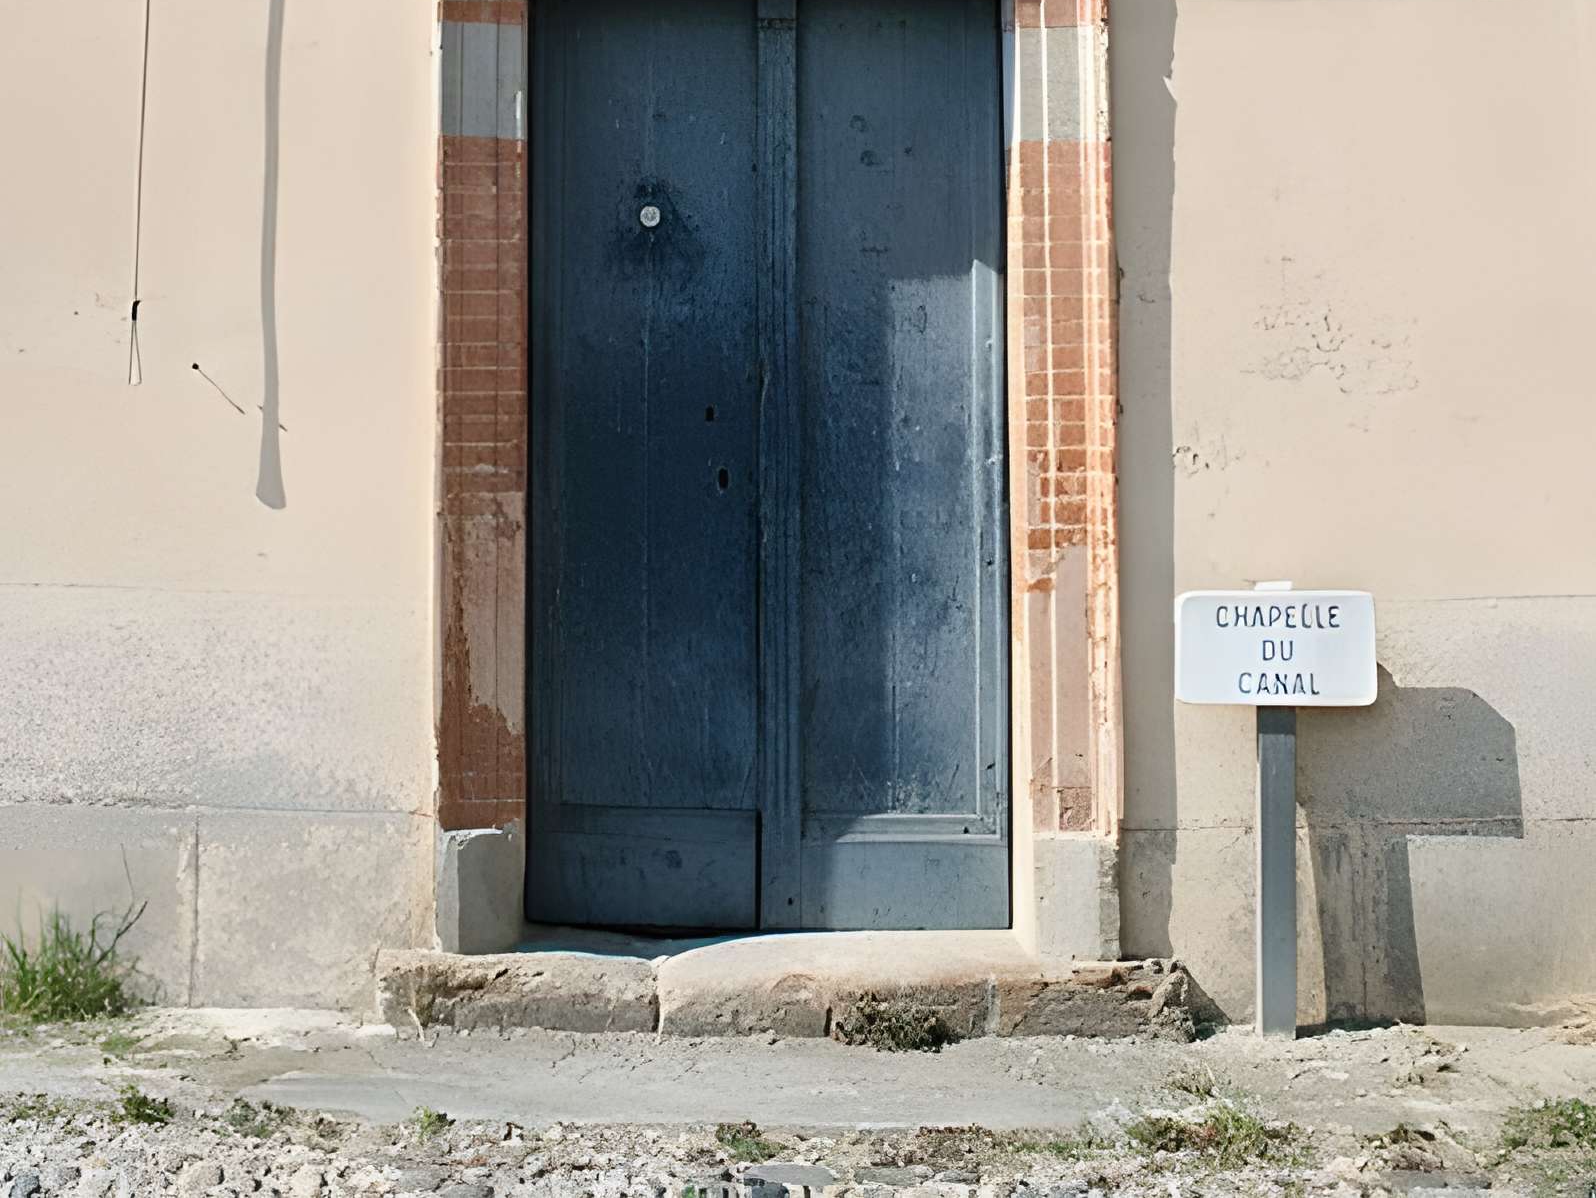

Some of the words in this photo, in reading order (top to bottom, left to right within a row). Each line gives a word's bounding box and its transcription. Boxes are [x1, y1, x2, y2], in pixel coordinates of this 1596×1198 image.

[1216, 604, 1340, 629] CHAPELLE
[1262, 640, 1293, 661] DU
[1238, 672, 1320, 695] CANAL
